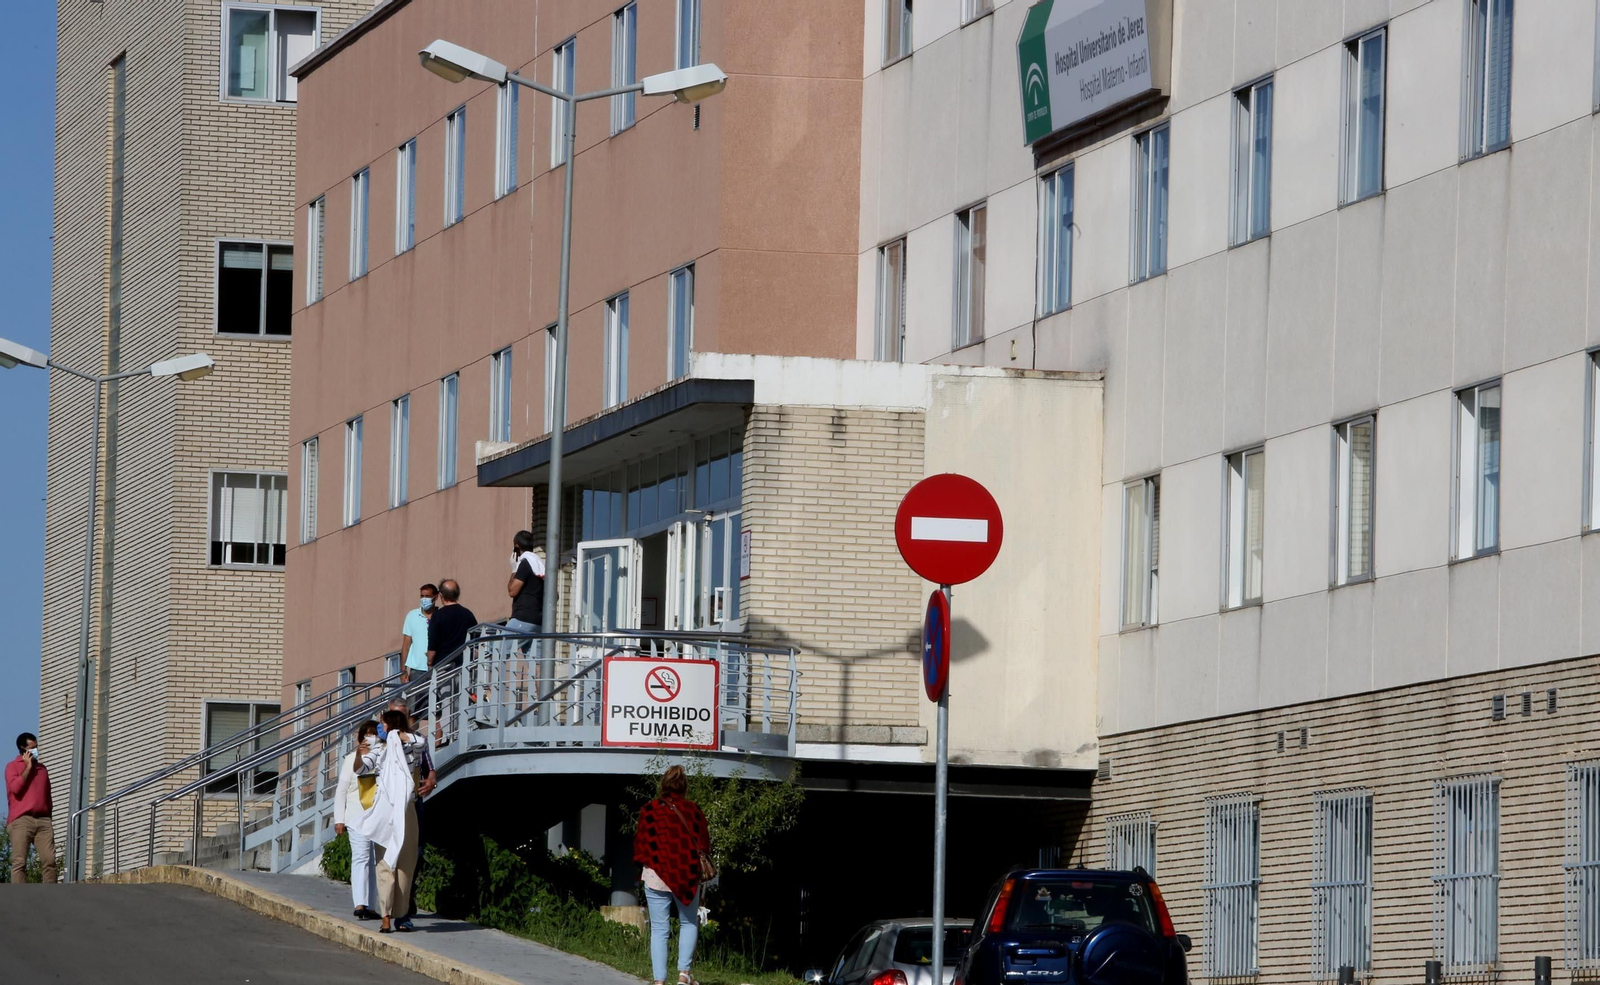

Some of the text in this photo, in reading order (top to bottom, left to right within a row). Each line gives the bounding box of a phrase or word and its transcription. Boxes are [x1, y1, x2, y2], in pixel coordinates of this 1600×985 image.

[1054, 17, 1144, 76] Hospital Universitario de Jerez
[1079, 71, 1102, 103] Hospital
[1102, 66, 1125, 92] Materno
[1127, 48, 1148, 79] Infantil
[611, 705, 711, 721] PROHIBIDO
[629, 722, 693, 737] FUMAR
